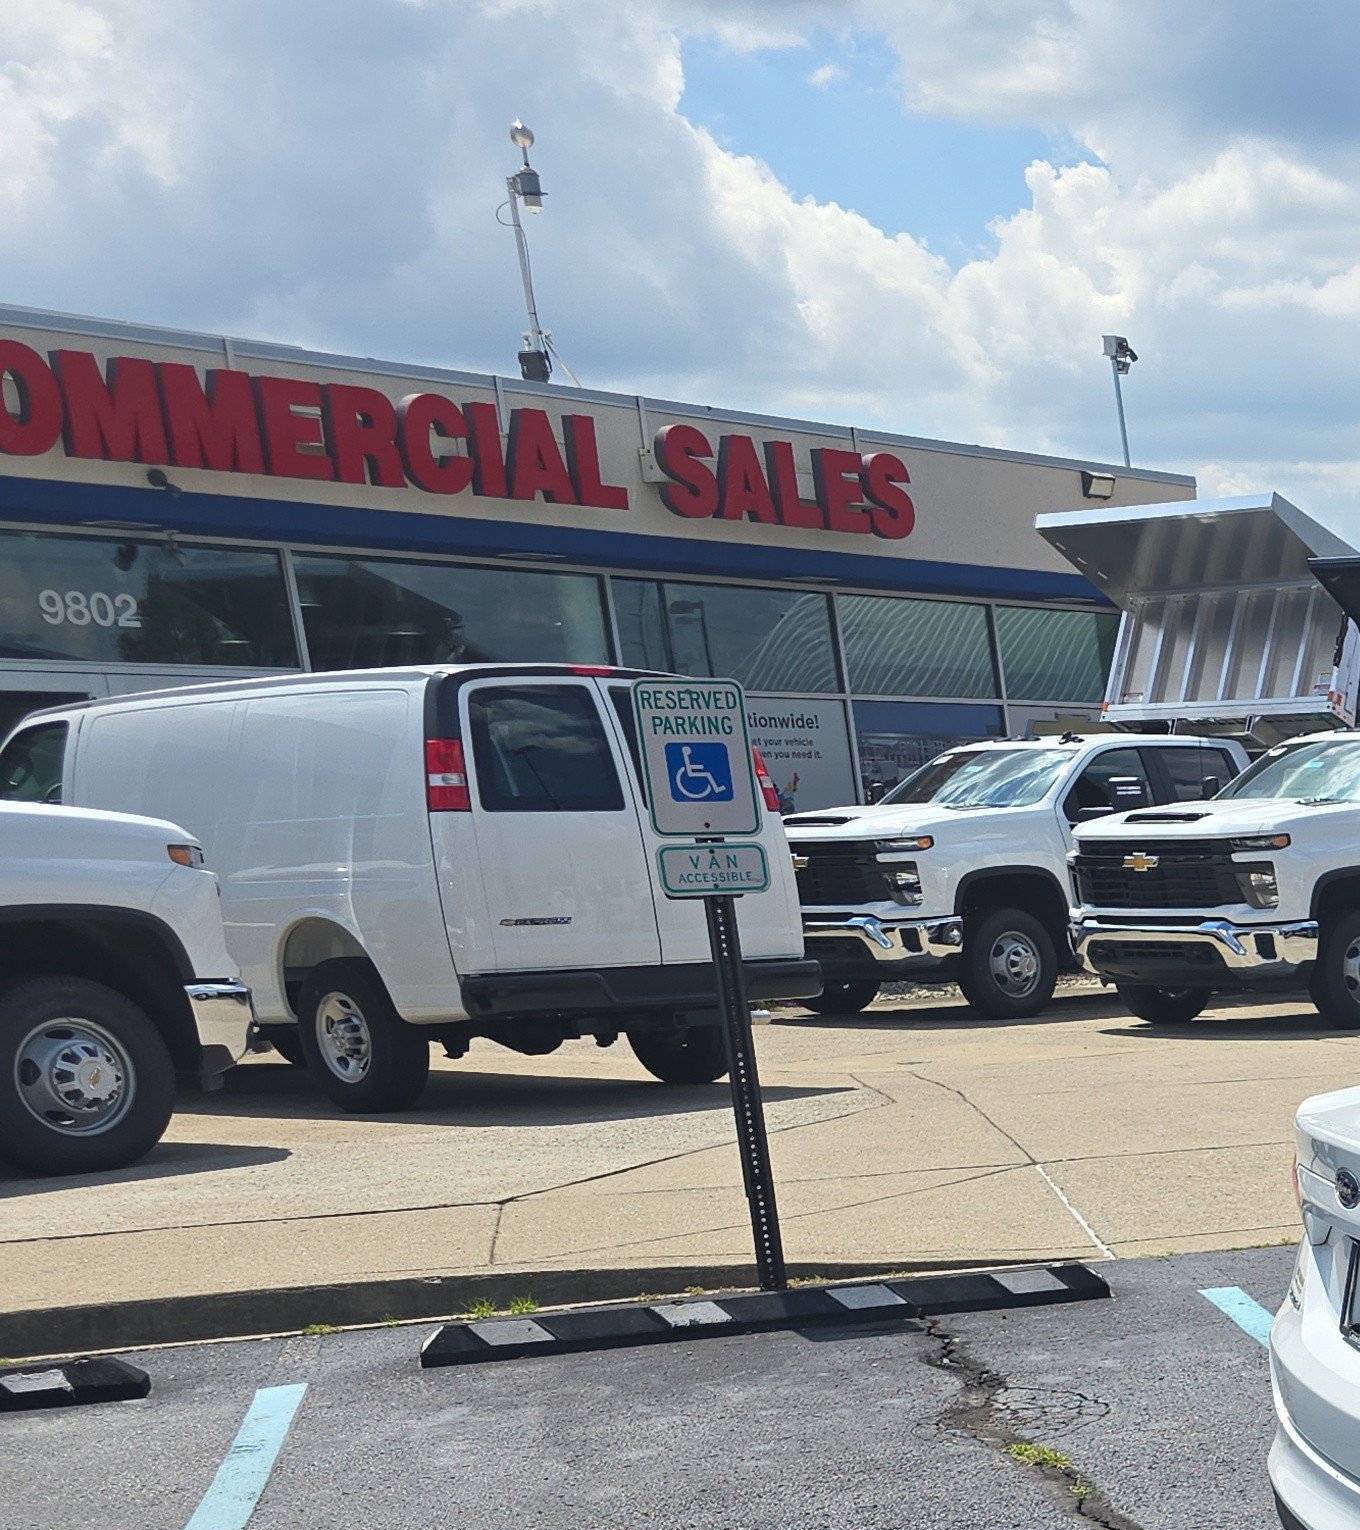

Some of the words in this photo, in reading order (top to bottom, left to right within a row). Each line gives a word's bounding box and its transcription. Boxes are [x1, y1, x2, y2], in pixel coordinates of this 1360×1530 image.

[655, 424, 915, 539] SALES
[39, 589, 142, 628] 9802
[640, 690, 738, 710] RESERVED
[652, 715, 733, 735] PARKING
[764, 739, 782, 747] your
[784, 738, 813, 746] vehicle
[774, 751, 790, 759] you
[689, 855, 738, 869] VAN
[678, 871, 752, 884] ACCESSIBLE
